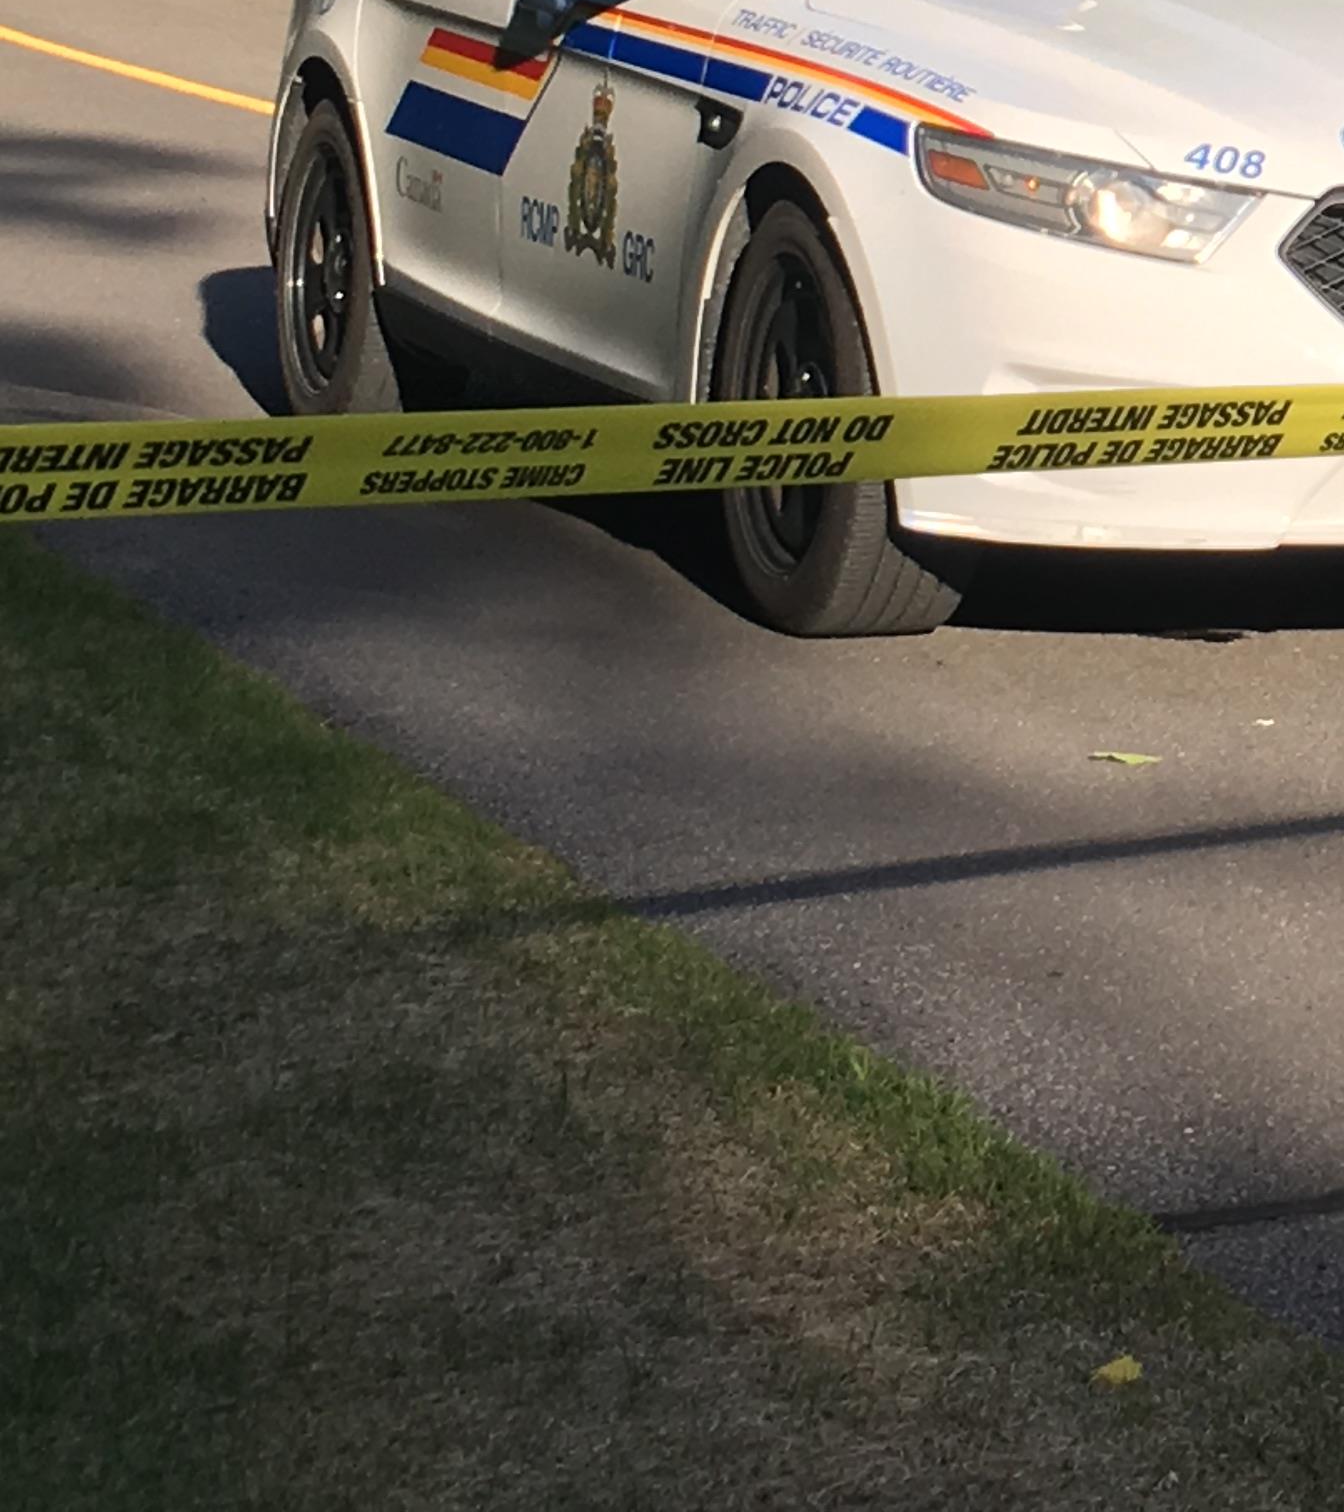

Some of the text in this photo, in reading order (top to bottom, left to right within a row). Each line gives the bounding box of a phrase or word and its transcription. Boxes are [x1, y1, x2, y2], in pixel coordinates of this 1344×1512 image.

[732, 8, 797, 39] TRAFFIC
[768, 75, 858, 127] POLICE
[1184, 143, 1266, 179] 408
[520, 196, 559, 248] RCMP
[623, 231, 655, 283] GRC
[652, 415, 894, 450] DO NOT CROSS
[1016, 399, 1293, 436] PASSAGE INTERDIT
[133, 435, 313, 469] PASSAGE
[382, 428, 598, 457] 1-800-222-8477
[986, 433, 1285, 470] BARRAGE DE POLICE
[360, 463, 586, 496] CRIME STOPPERS
[652, 451, 855, 486] POLICE LINE
[60, 480, 120, 512] DE
[122, 473, 309, 509] BARRAGE
